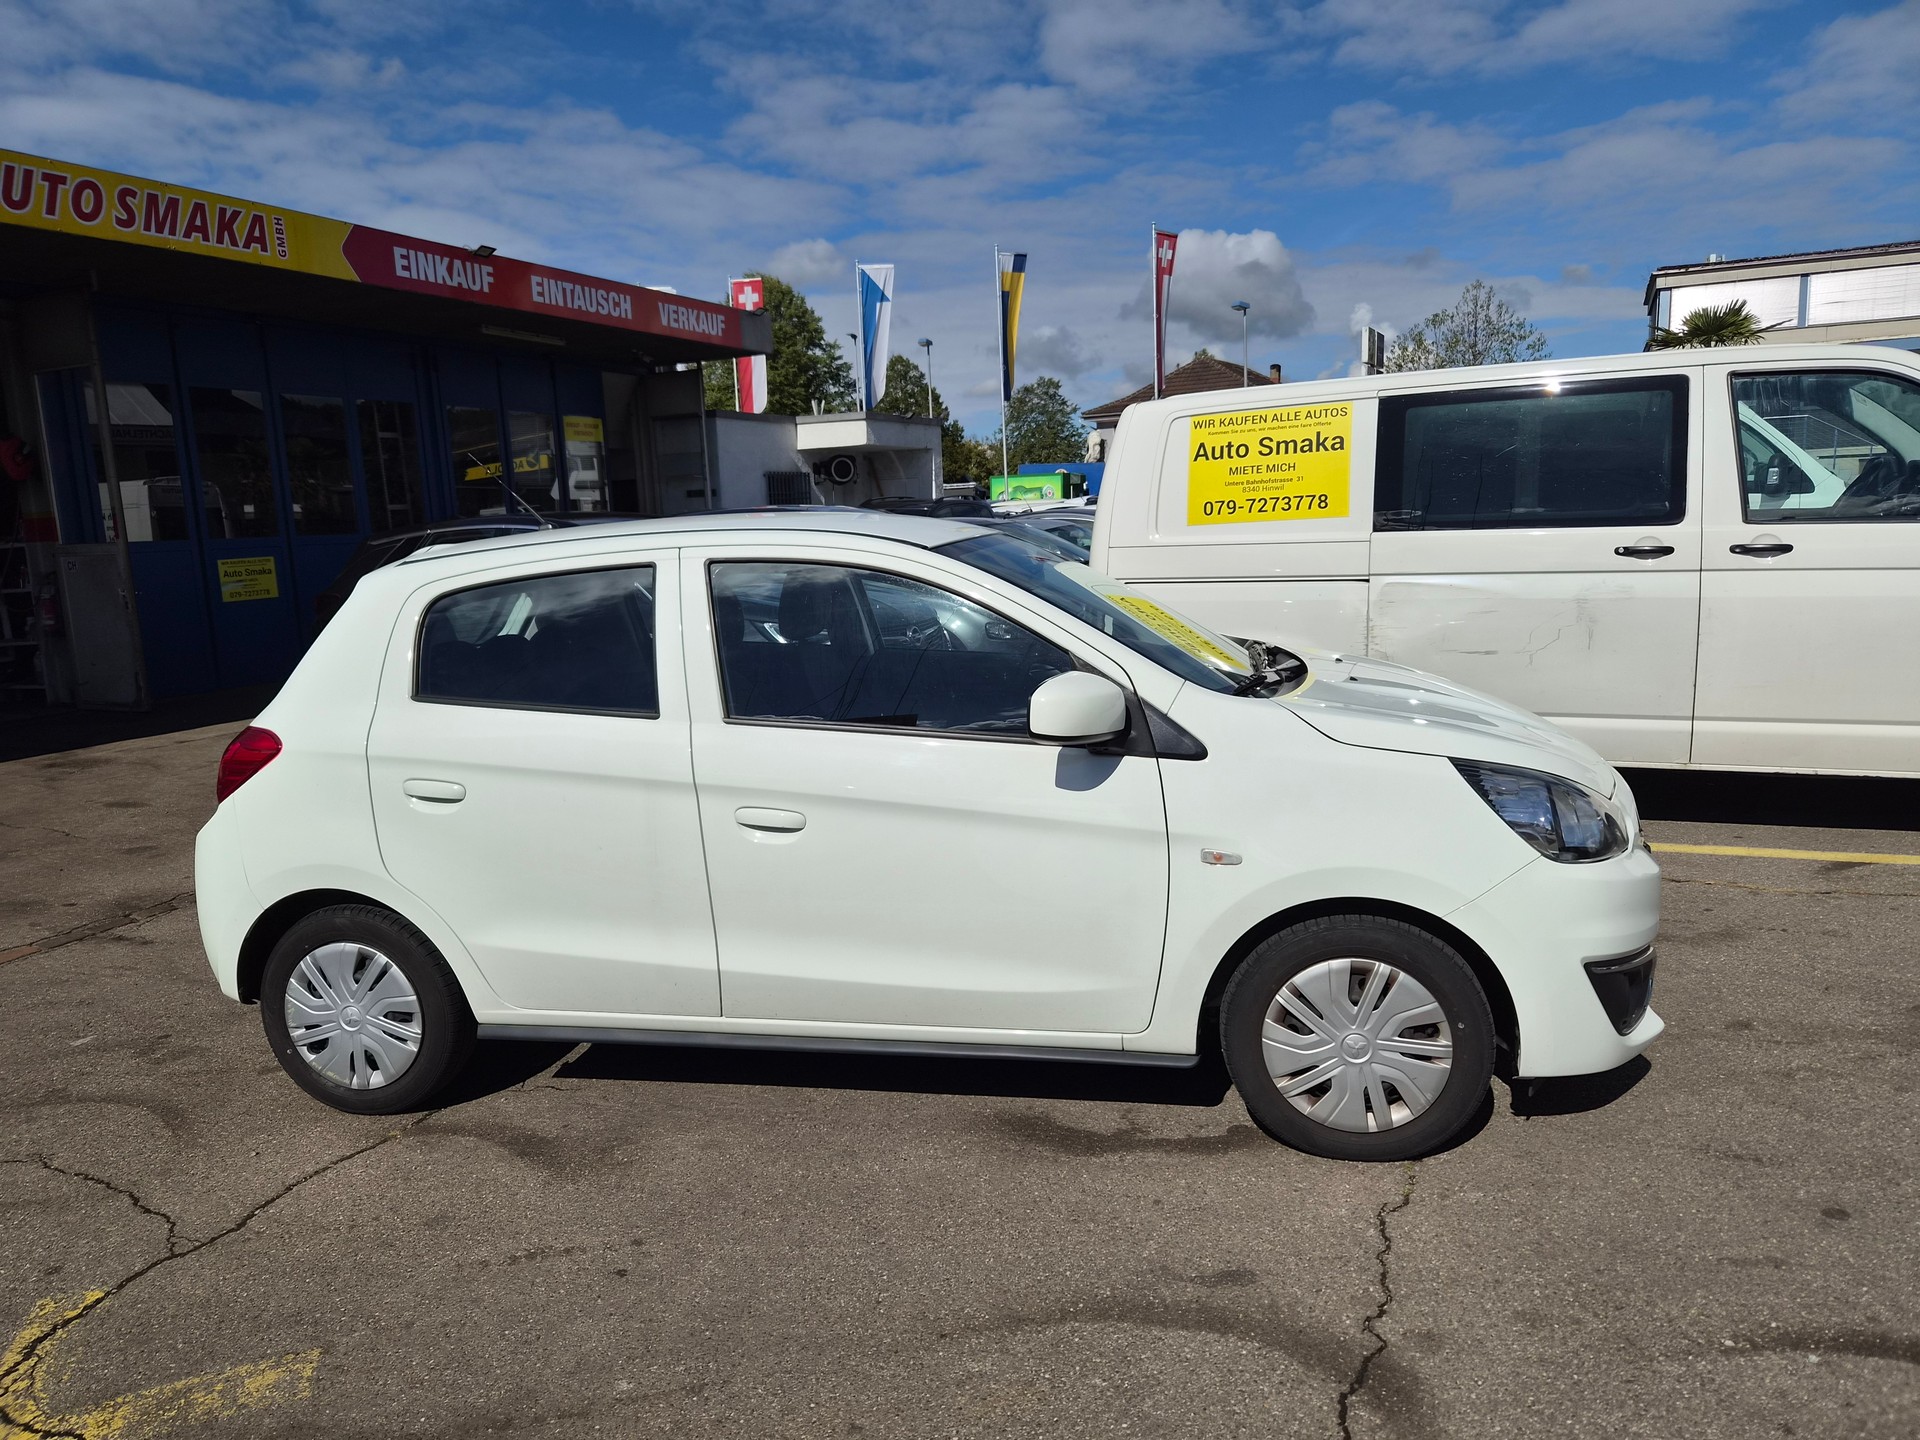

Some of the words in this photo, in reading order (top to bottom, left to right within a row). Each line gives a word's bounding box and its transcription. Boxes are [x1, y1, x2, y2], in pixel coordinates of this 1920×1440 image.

[113, 185, 270, 255] SMAKA
[273, 215, 289, 260] GMBH
[393, 246, 494, 293] EINKAUF
[530, 275, 632, 320] EINTAUSCH
[657, 302, 726, 337] VERKAUF
[1193, 418, 1216, 430] WIR
[1219, 414, 1268, 428] KAUFEN
[1270, 410, 1302, 423] ALLE
[1304, 406, 1348, 420] AUTOS
[1192, 441, 1250, 462] Auto
[1257, 430, 1346, 457] Smaka
[1224, 479, 1245, 487] Untere
[1245, 476, 1294, 486] Bahnhofstrasse
[1228, 464, 1263, 476] MIETE
[1265, 462, 1297, 474] MICH
[1241, 485, 1261, 494] 8340
[1261, 483, 1285, 492] Hinwil
[1203, 493, 1329, 516] 079-7273778
[223, 569, 243, 578] Auto
[244, 566, 272, 577] Smaka
